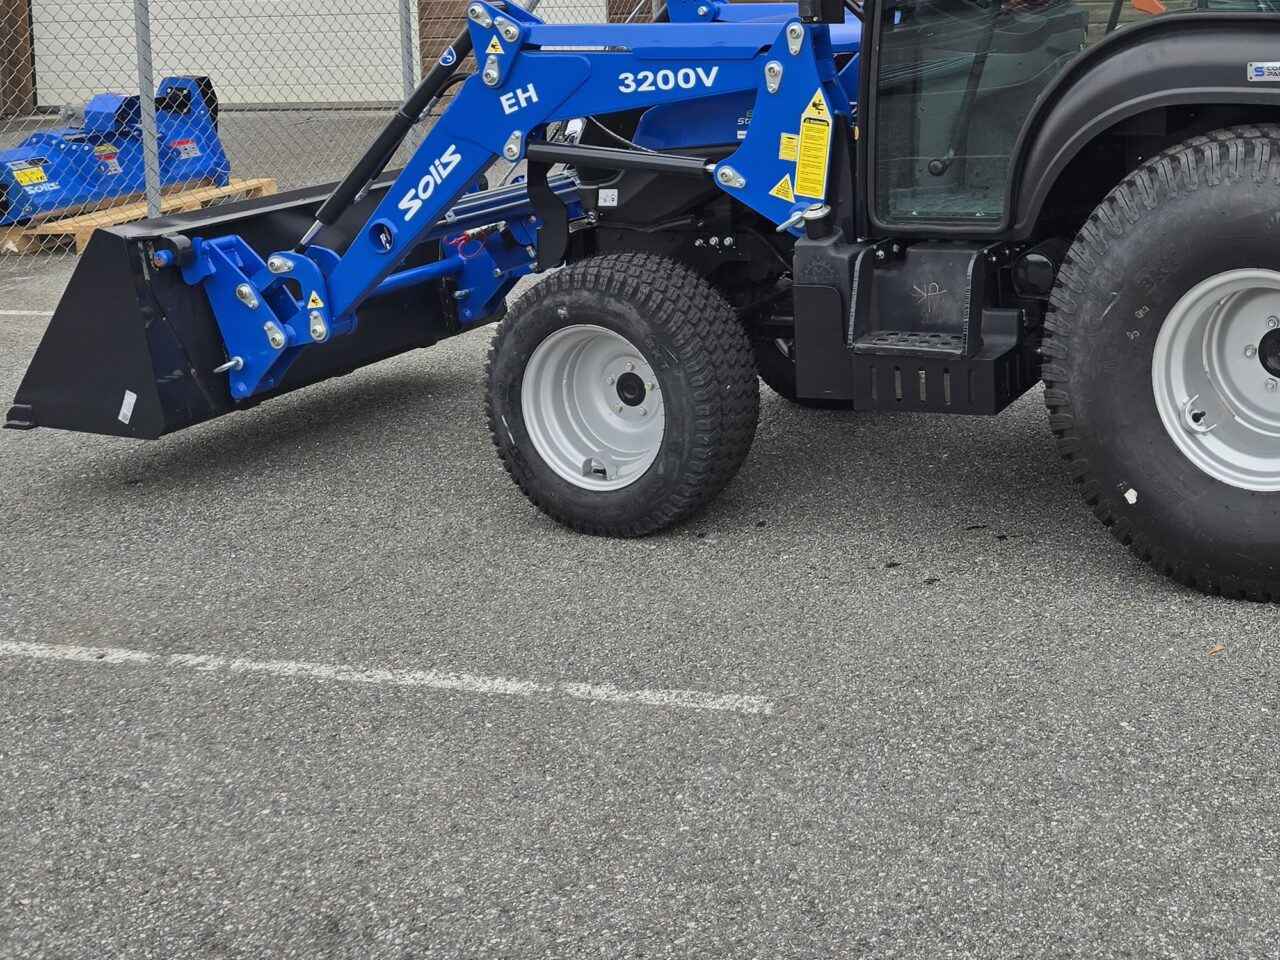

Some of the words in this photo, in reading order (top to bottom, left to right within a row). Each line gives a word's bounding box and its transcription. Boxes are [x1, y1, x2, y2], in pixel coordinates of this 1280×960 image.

[617, 66, 720, 93] 3200V
[500, 83, 539, 115] EH
[397, 144, 462, 222] Solis
